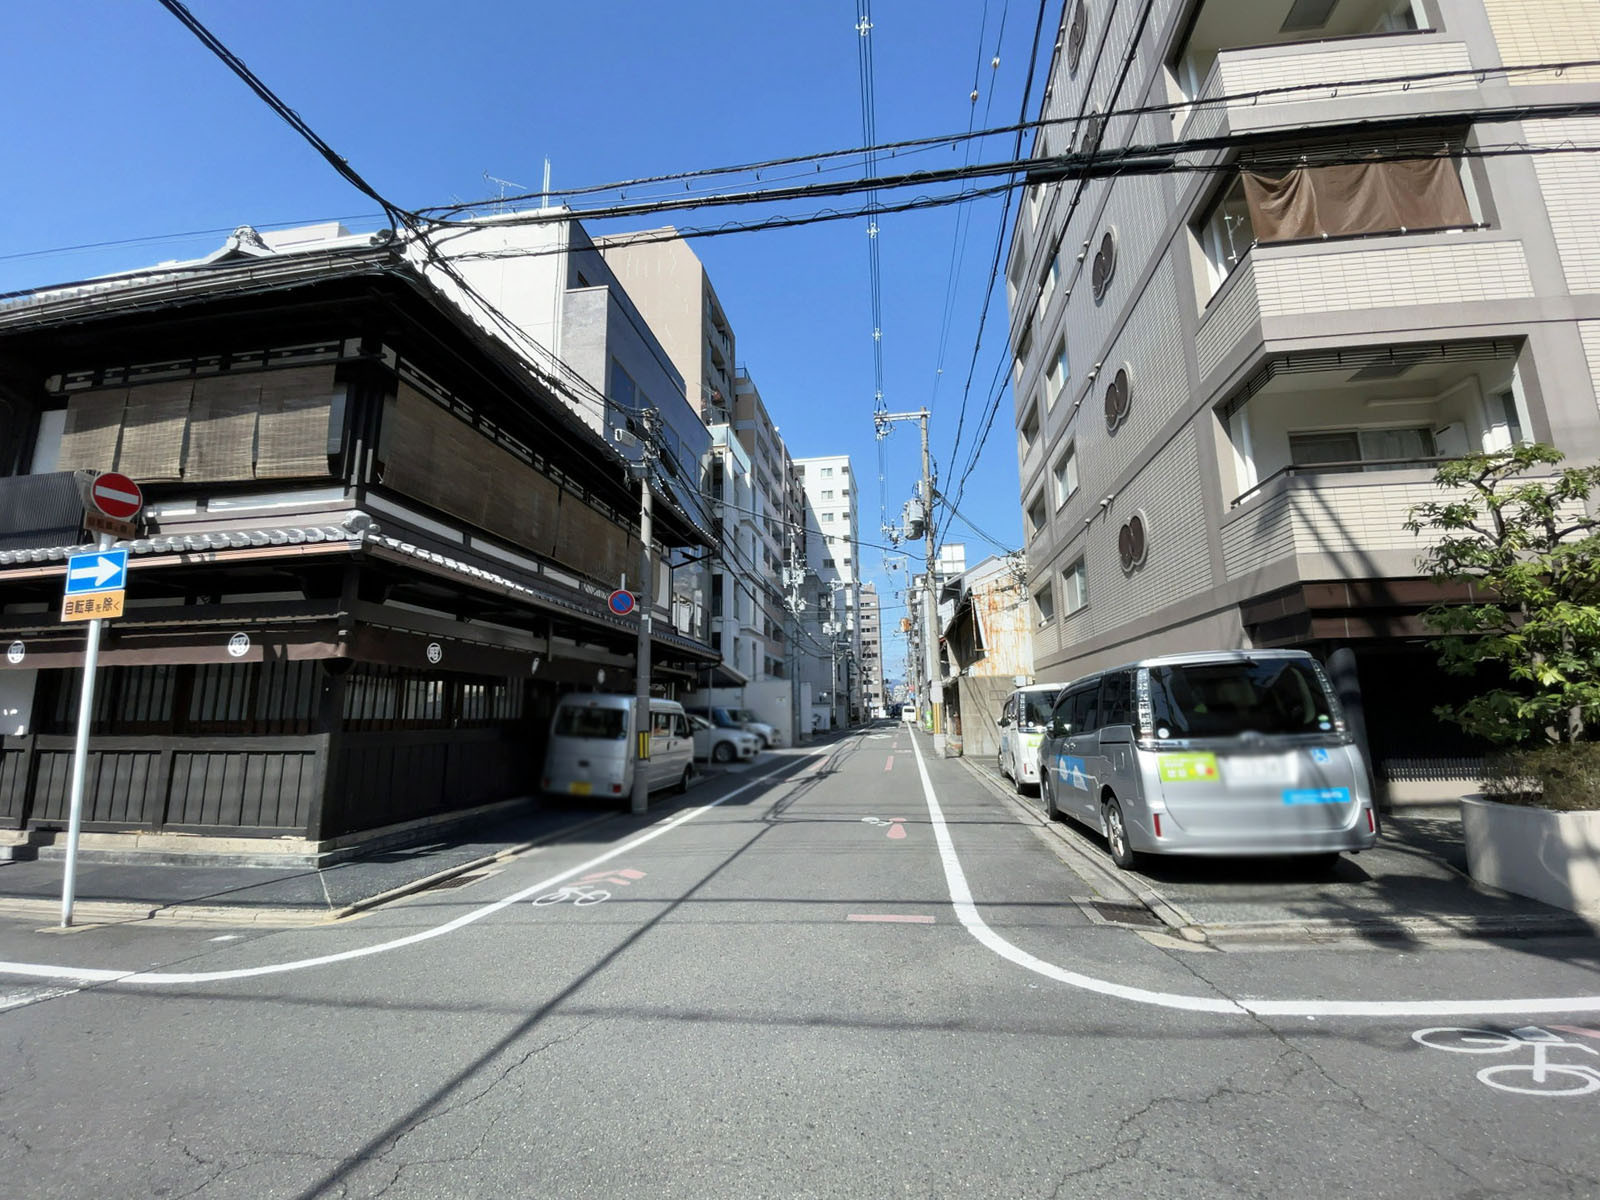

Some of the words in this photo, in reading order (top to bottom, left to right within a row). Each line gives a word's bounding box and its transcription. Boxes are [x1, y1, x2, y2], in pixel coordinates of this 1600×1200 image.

[64, 596, 121, 615] 自転車を除く
